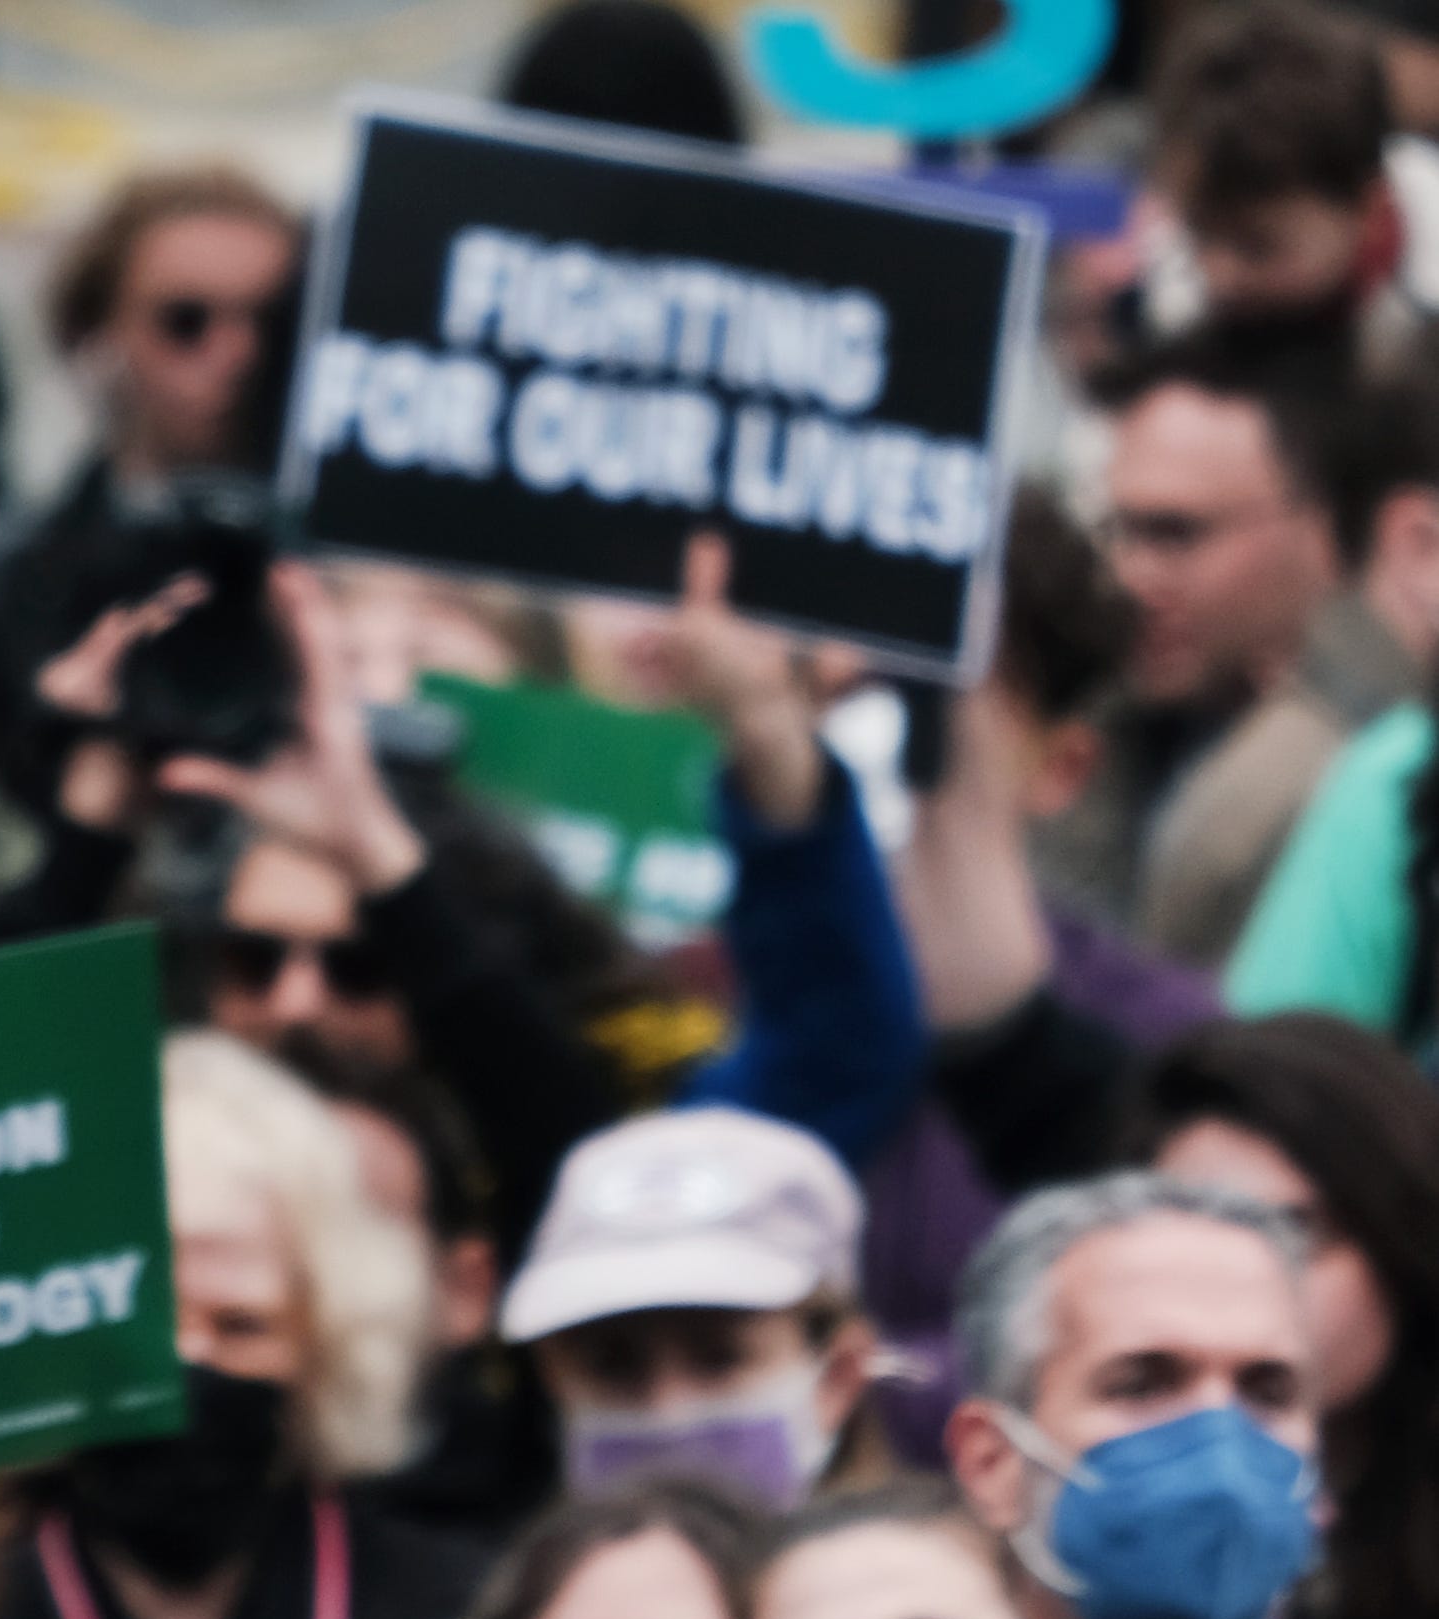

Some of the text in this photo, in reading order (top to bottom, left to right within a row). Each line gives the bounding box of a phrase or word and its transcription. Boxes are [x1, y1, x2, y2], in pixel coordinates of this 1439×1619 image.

[443, 225, 881, 412] FIGHTING
[301, 330, 989, 562] FOR OUR LIVES
